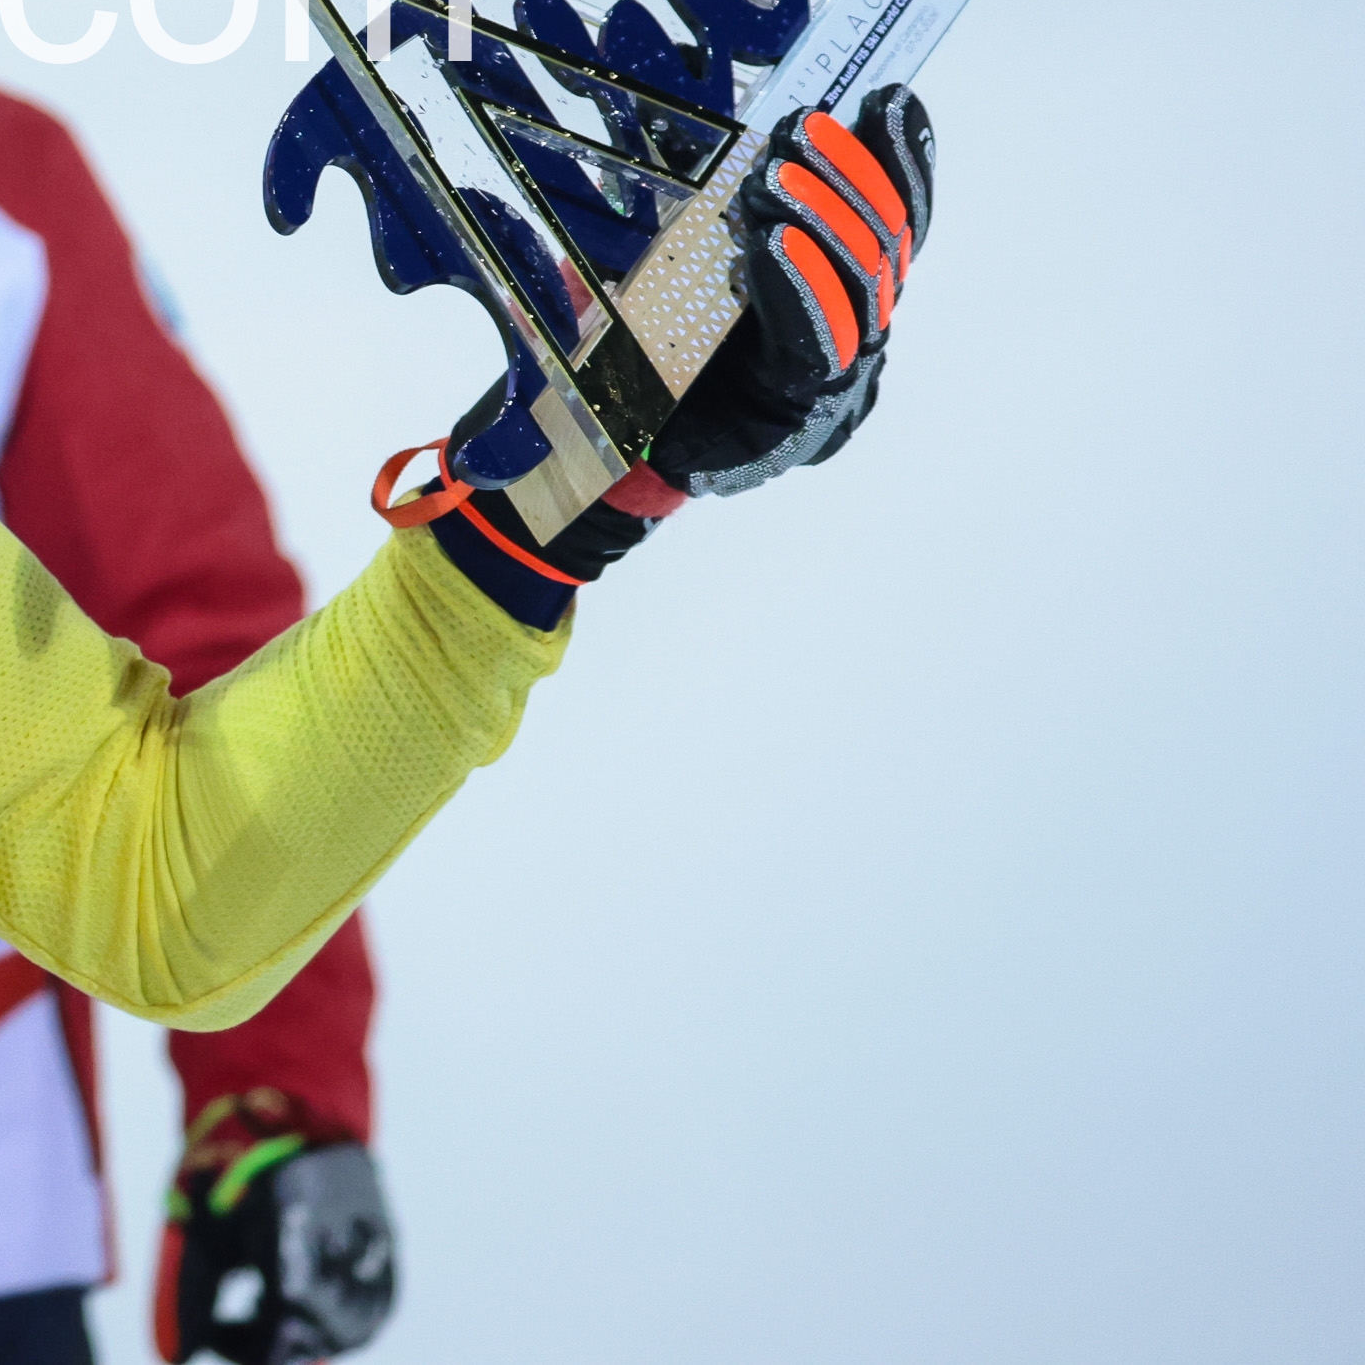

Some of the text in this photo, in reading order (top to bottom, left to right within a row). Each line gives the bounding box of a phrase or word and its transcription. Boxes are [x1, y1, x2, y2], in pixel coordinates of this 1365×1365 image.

[825, 83, 844, 106] 3tre
[839, 61, 859, 87] Audi
[854, 47, 871, 66] FIS
[864, 31, 881, 51] Ski
[874, 5, 901, 36] World
